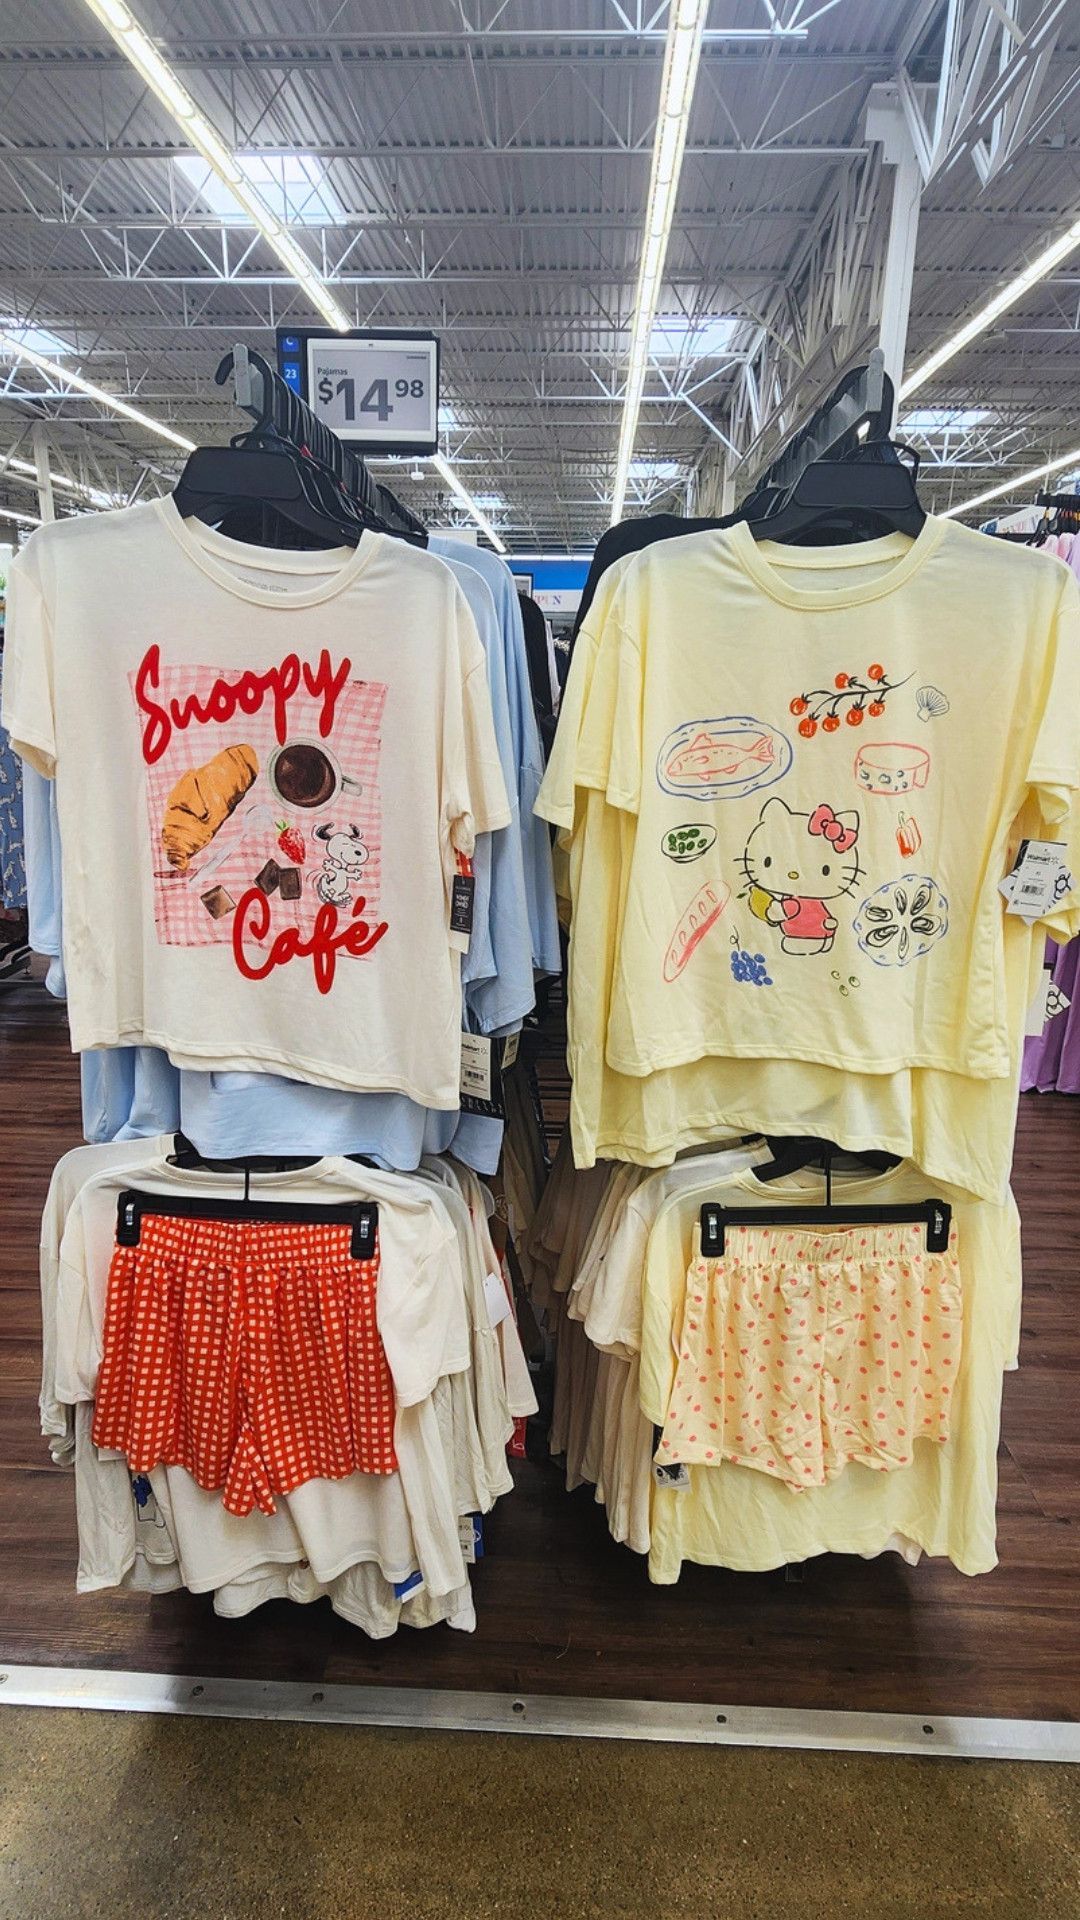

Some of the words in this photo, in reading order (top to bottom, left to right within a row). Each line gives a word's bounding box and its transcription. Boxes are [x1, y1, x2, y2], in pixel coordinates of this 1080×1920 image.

[285, 369, 297, 379] 23
[317, 367, 348, 376] Pajamas
[135, 643, 352, 765] Snoopy
[232, 887, 389, 995] Café
